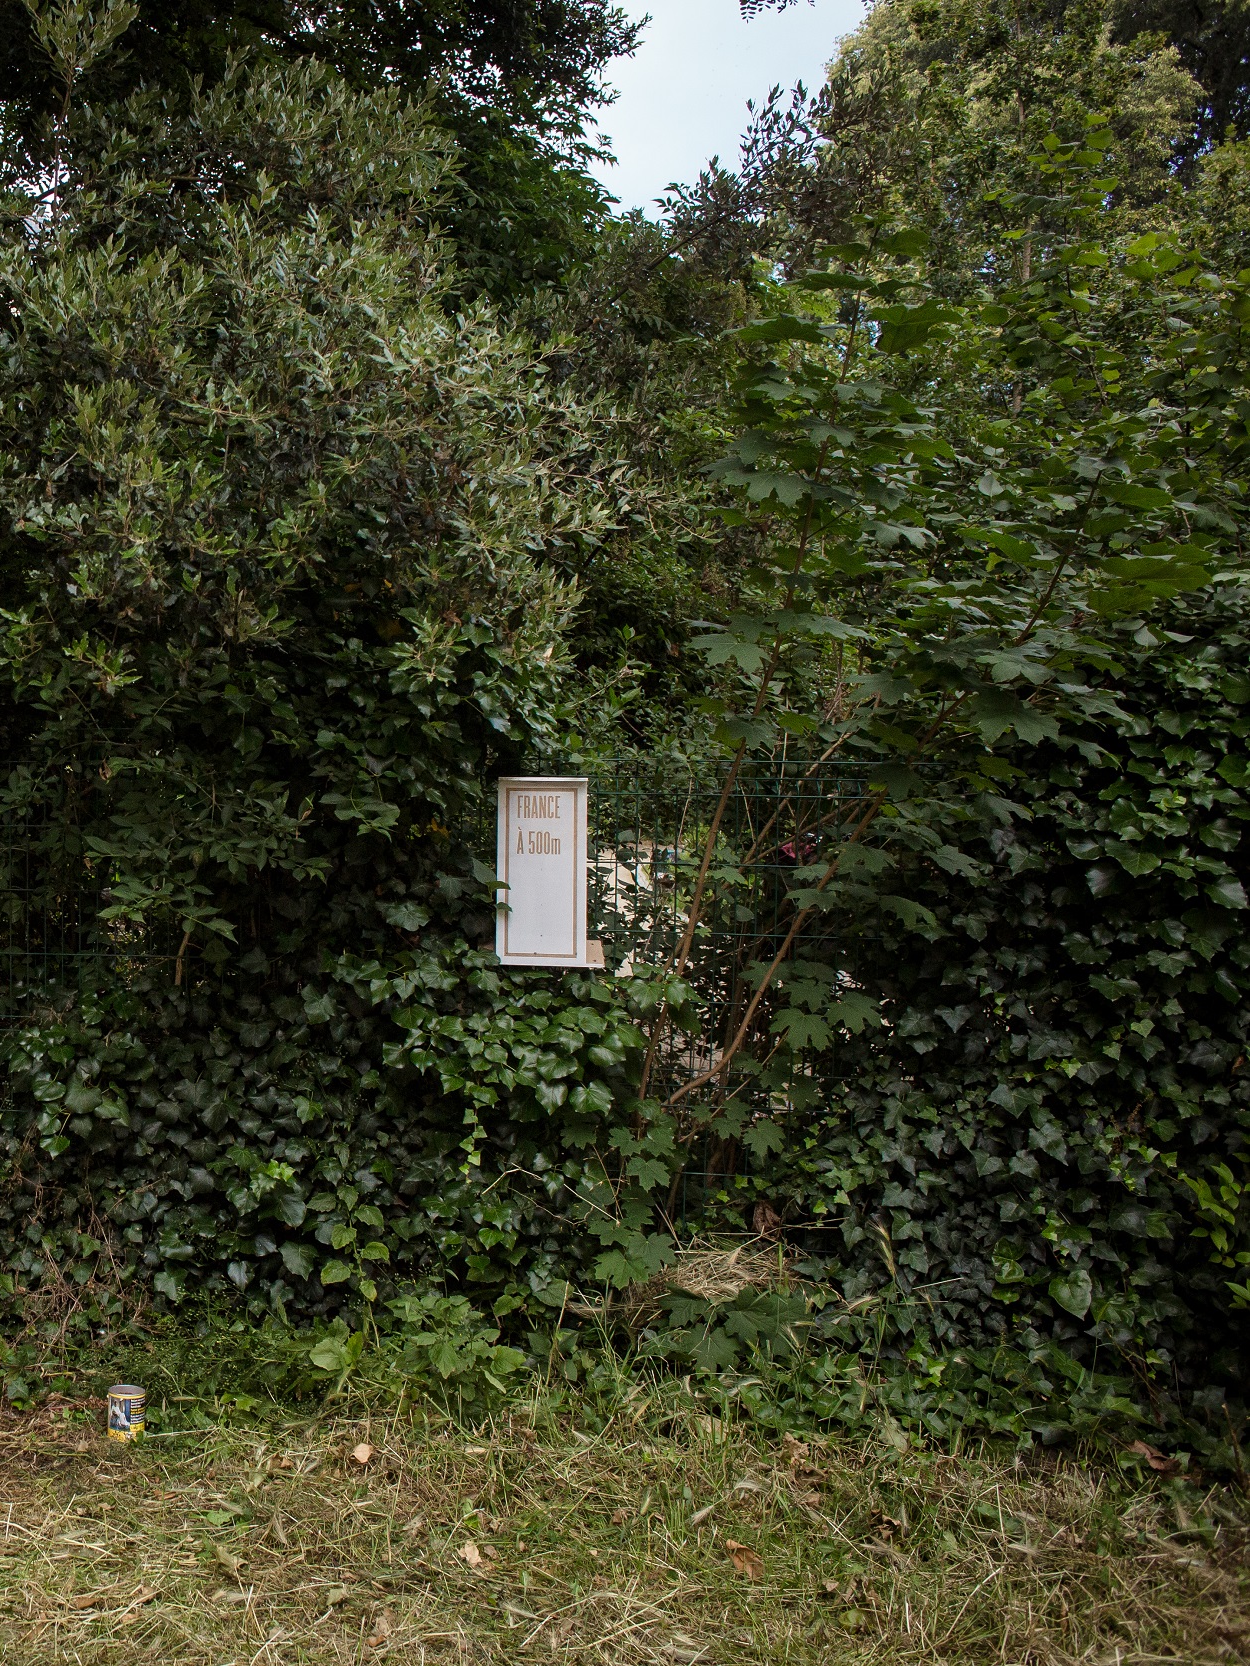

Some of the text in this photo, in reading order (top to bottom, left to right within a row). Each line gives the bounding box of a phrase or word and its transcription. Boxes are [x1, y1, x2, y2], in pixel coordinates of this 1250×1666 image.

[517, 795, 561, 819] FRANCE
[516, 826, 561, 855] À 500m
